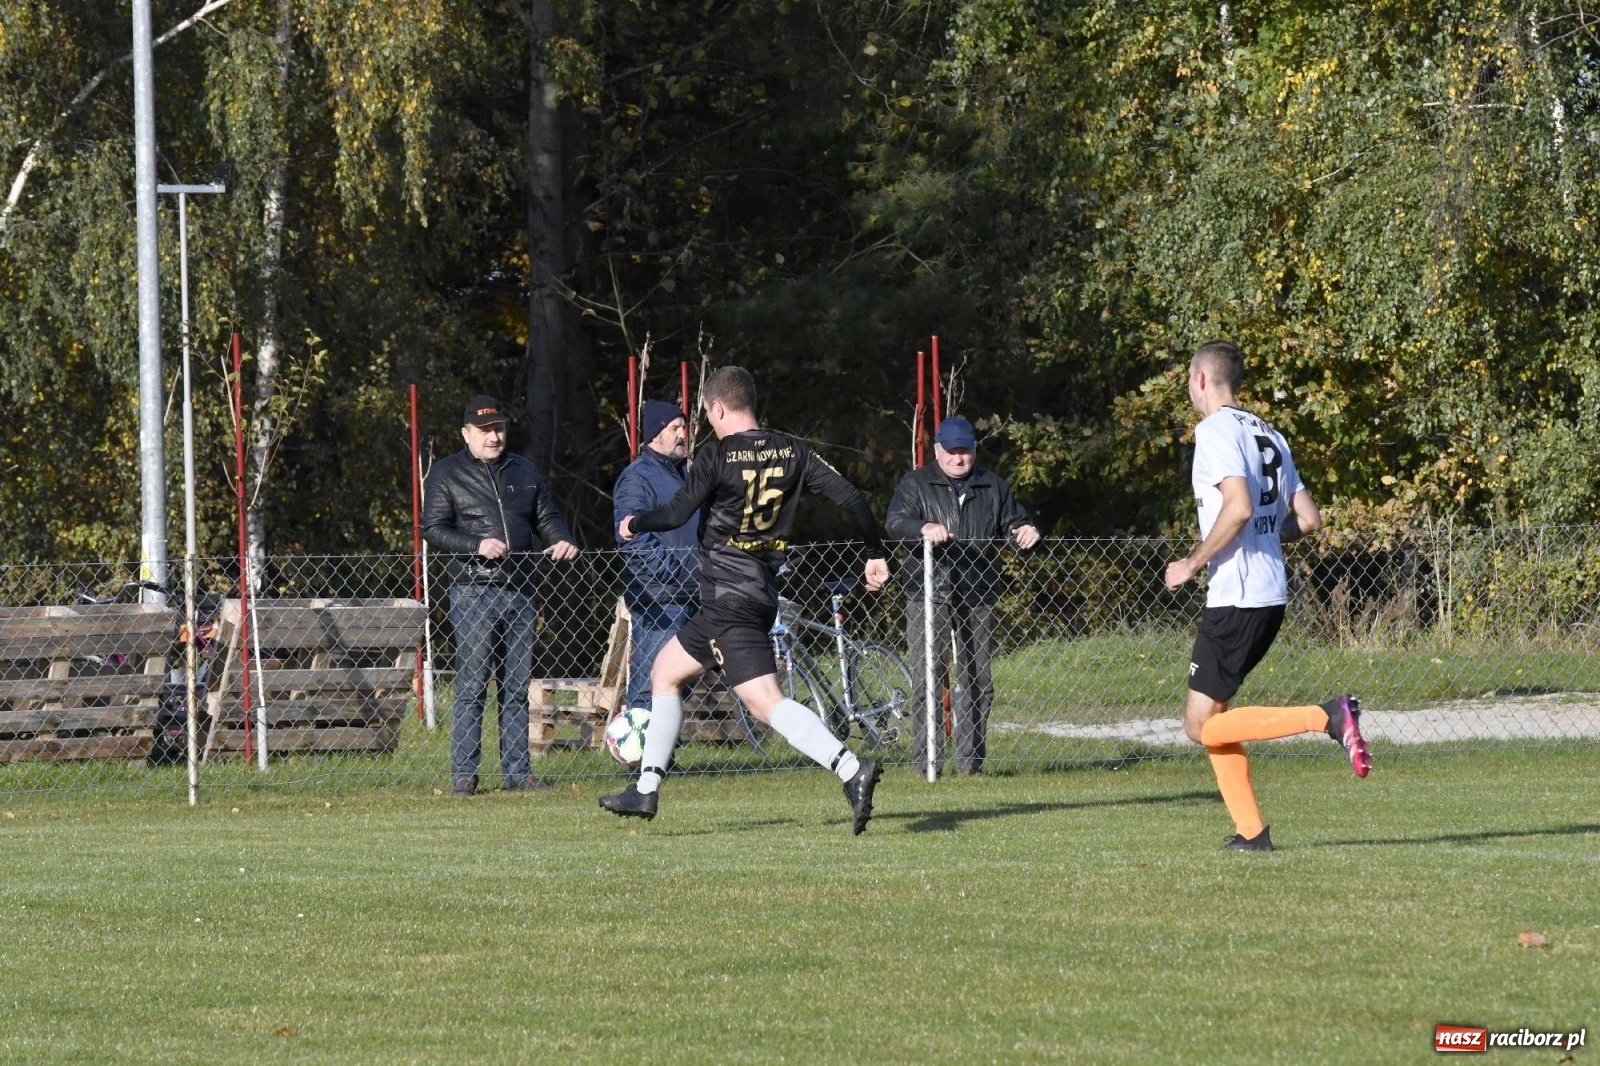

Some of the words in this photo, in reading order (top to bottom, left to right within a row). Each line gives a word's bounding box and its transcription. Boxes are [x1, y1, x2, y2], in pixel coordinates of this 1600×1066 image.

[726, 450, 755, 463] CZARNI
[1254, 434, 1283, 507] 3
[740, 466, 784, 532] 15
